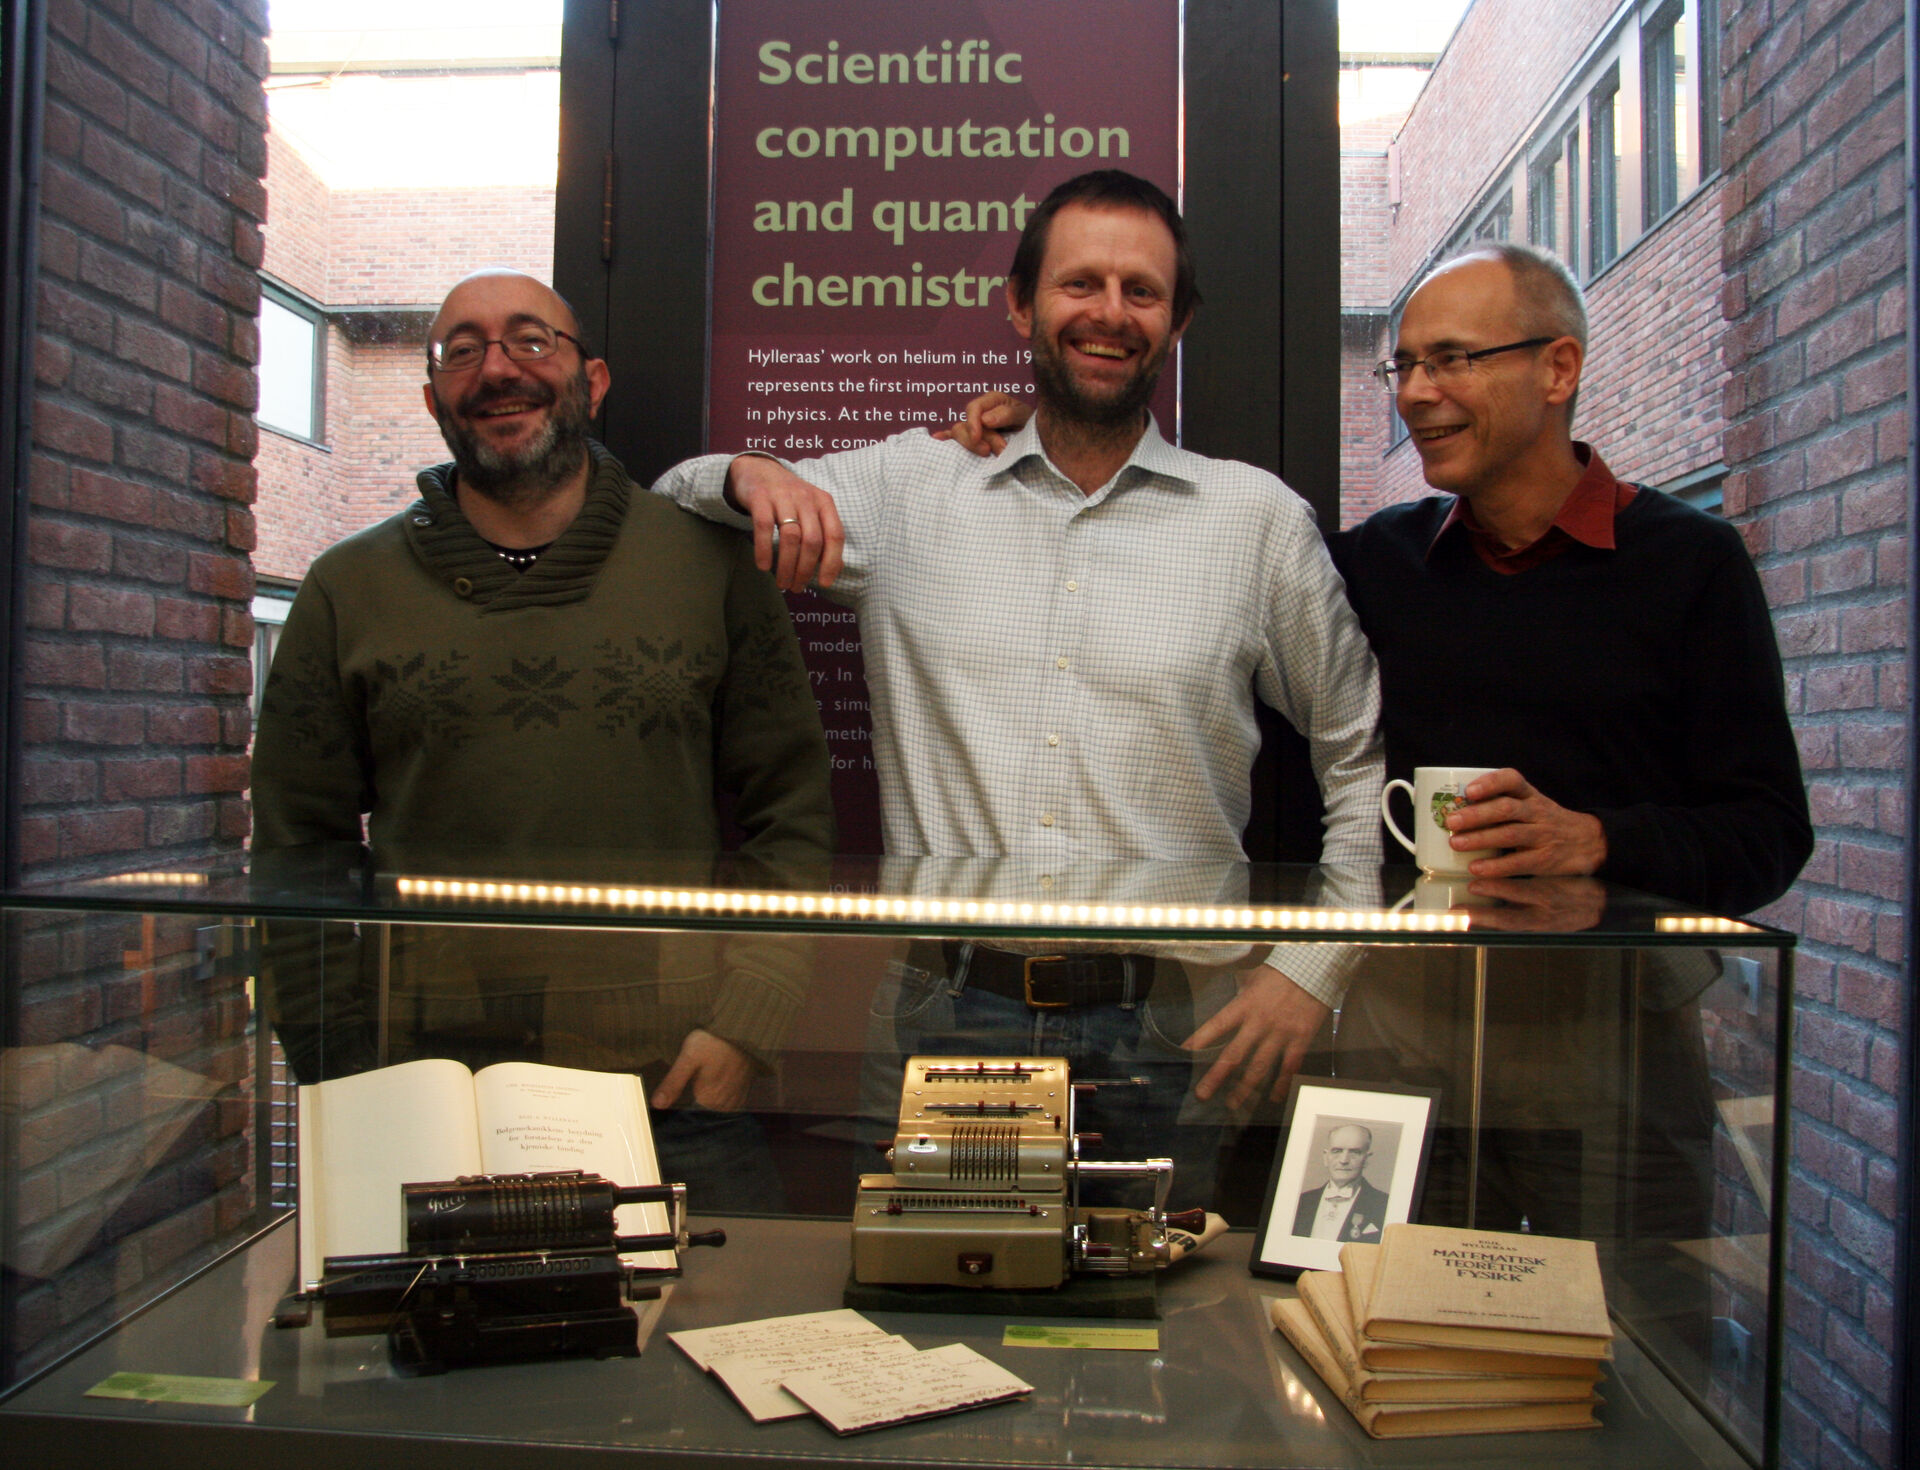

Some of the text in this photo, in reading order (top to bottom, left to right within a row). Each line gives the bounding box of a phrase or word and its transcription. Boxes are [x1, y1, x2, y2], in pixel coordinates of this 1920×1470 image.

[757, 39, 1023, 85] Scientific
[755, 112, 1131, 171] computation
[752, 187, 1040, 246] and quant
[830, 349, 872, 364] work
[877, 352, 898, 364] on
[904, 349, 957, 365] helium
[962, 350, 976, 364] in
[982, 350, 1008, 365] the
[1015, 350, 1033, 366] 19
[747, 378, 1036, 397] represents the first important use o
[746, 407, 761, 421] in
[767, 406, 832, 425] physics.
[838, 407, 859, 421] At
[865, 406, 893, 421] the
[899, 407, 944, 423] time,
[746, 434, 884, 449] tric desk com
[809, 638, 863, 653] moder
[807, 667, 852, 685] ry. In
[834, 698, 871, 711] simu
[825, 726, 873, 741] metho
[1432, 1248, 1547, 1267] MATEMATISK
[1443, 1258, 1537, 1275] TEORETISK
[1457, 1268, 1524, 1283] FYSIKK
